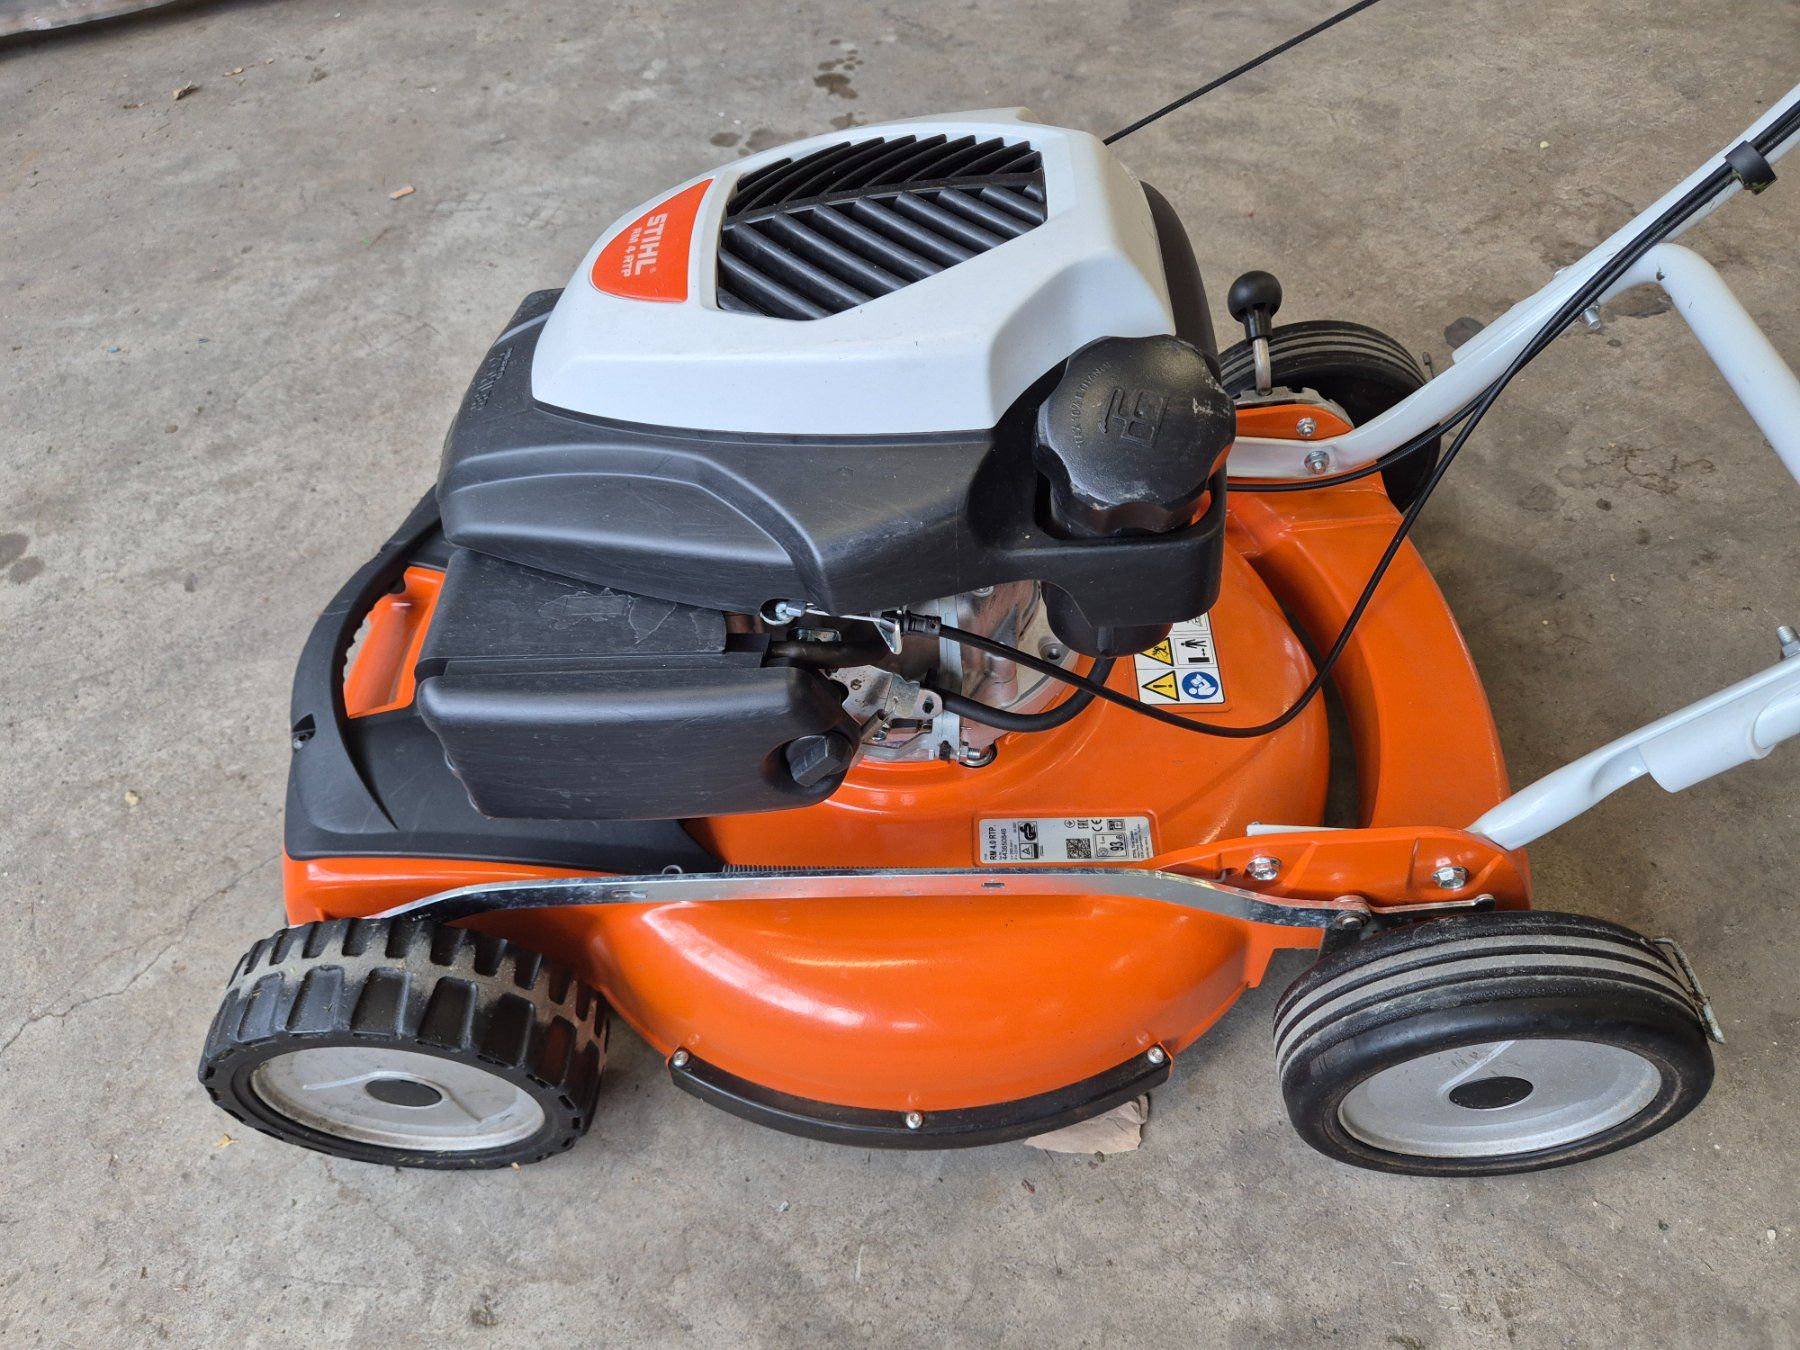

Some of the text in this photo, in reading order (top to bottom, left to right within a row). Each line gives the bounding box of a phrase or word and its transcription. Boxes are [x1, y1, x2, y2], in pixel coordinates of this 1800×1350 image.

[635, 213, 668, 276] STIHL
[621, 227, 642, 277] RM 4 RTP
[988, 826, 997, 839] RTP
[1110, 841, 1124, 851] 93
[989, 850, 997, 860] RM
